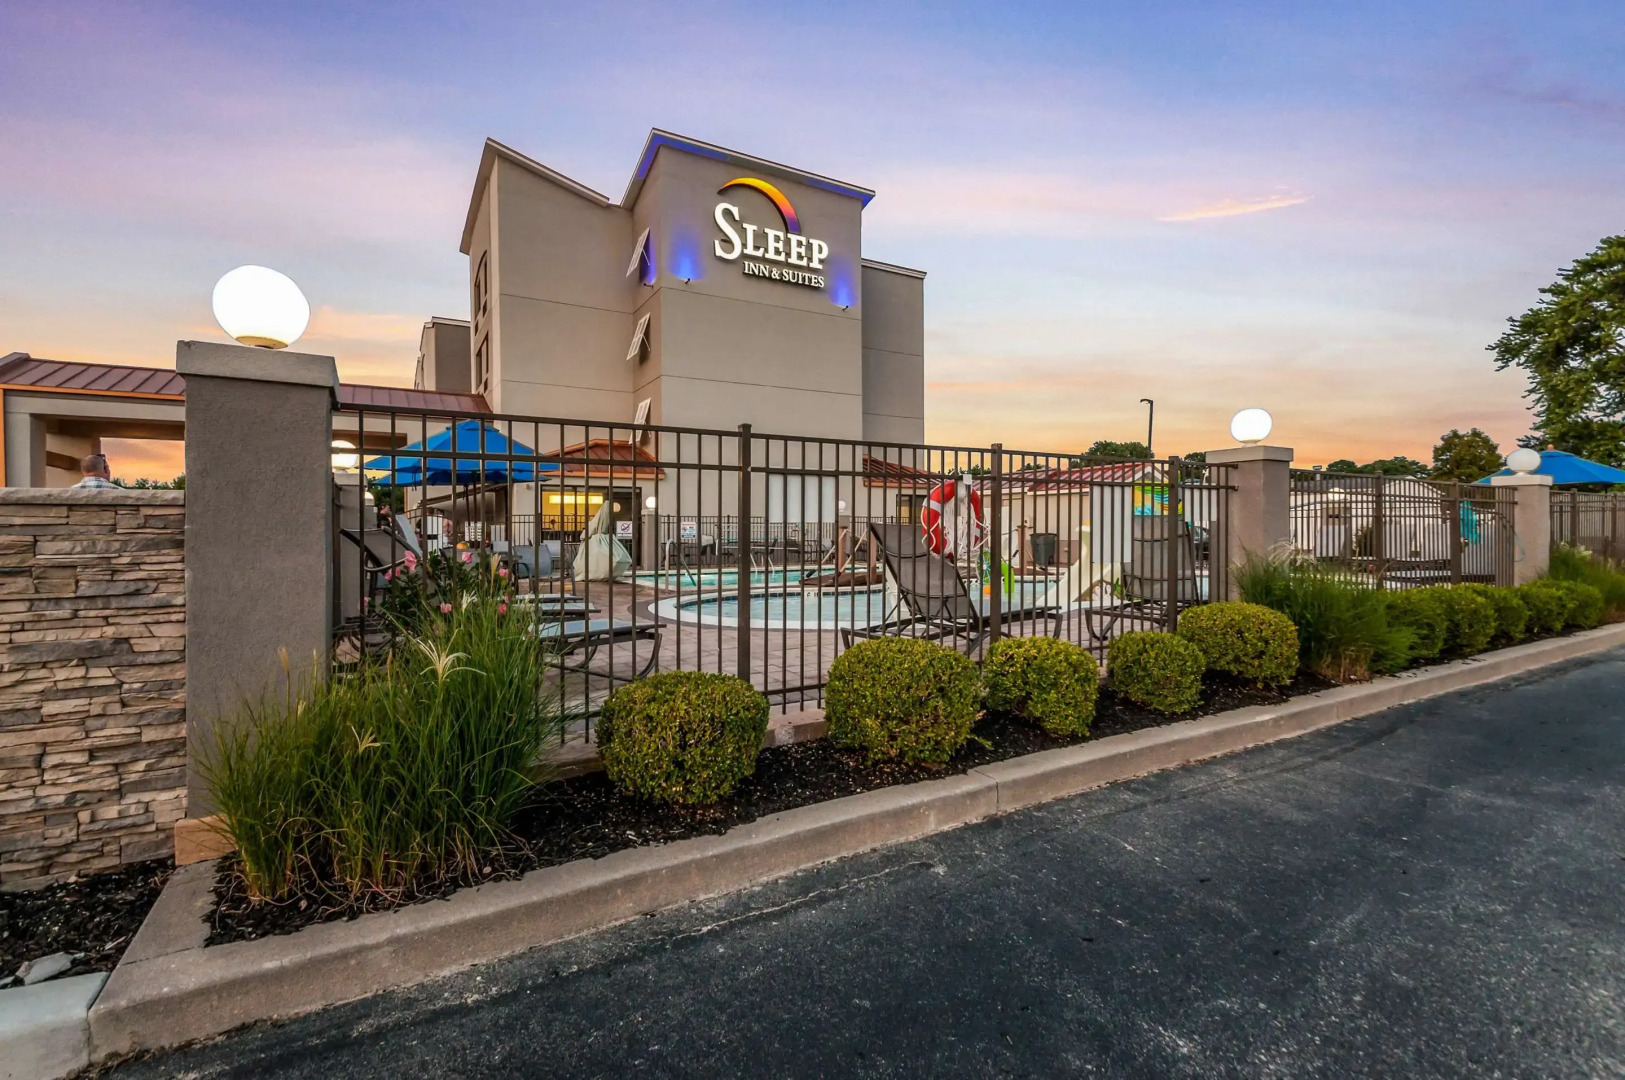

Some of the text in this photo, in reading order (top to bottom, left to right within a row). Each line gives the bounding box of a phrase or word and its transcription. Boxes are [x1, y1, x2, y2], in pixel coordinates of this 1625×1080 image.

[714, 202, 829, 269] SLEEP
[743, 261, 825, 288] INN & SUITES
